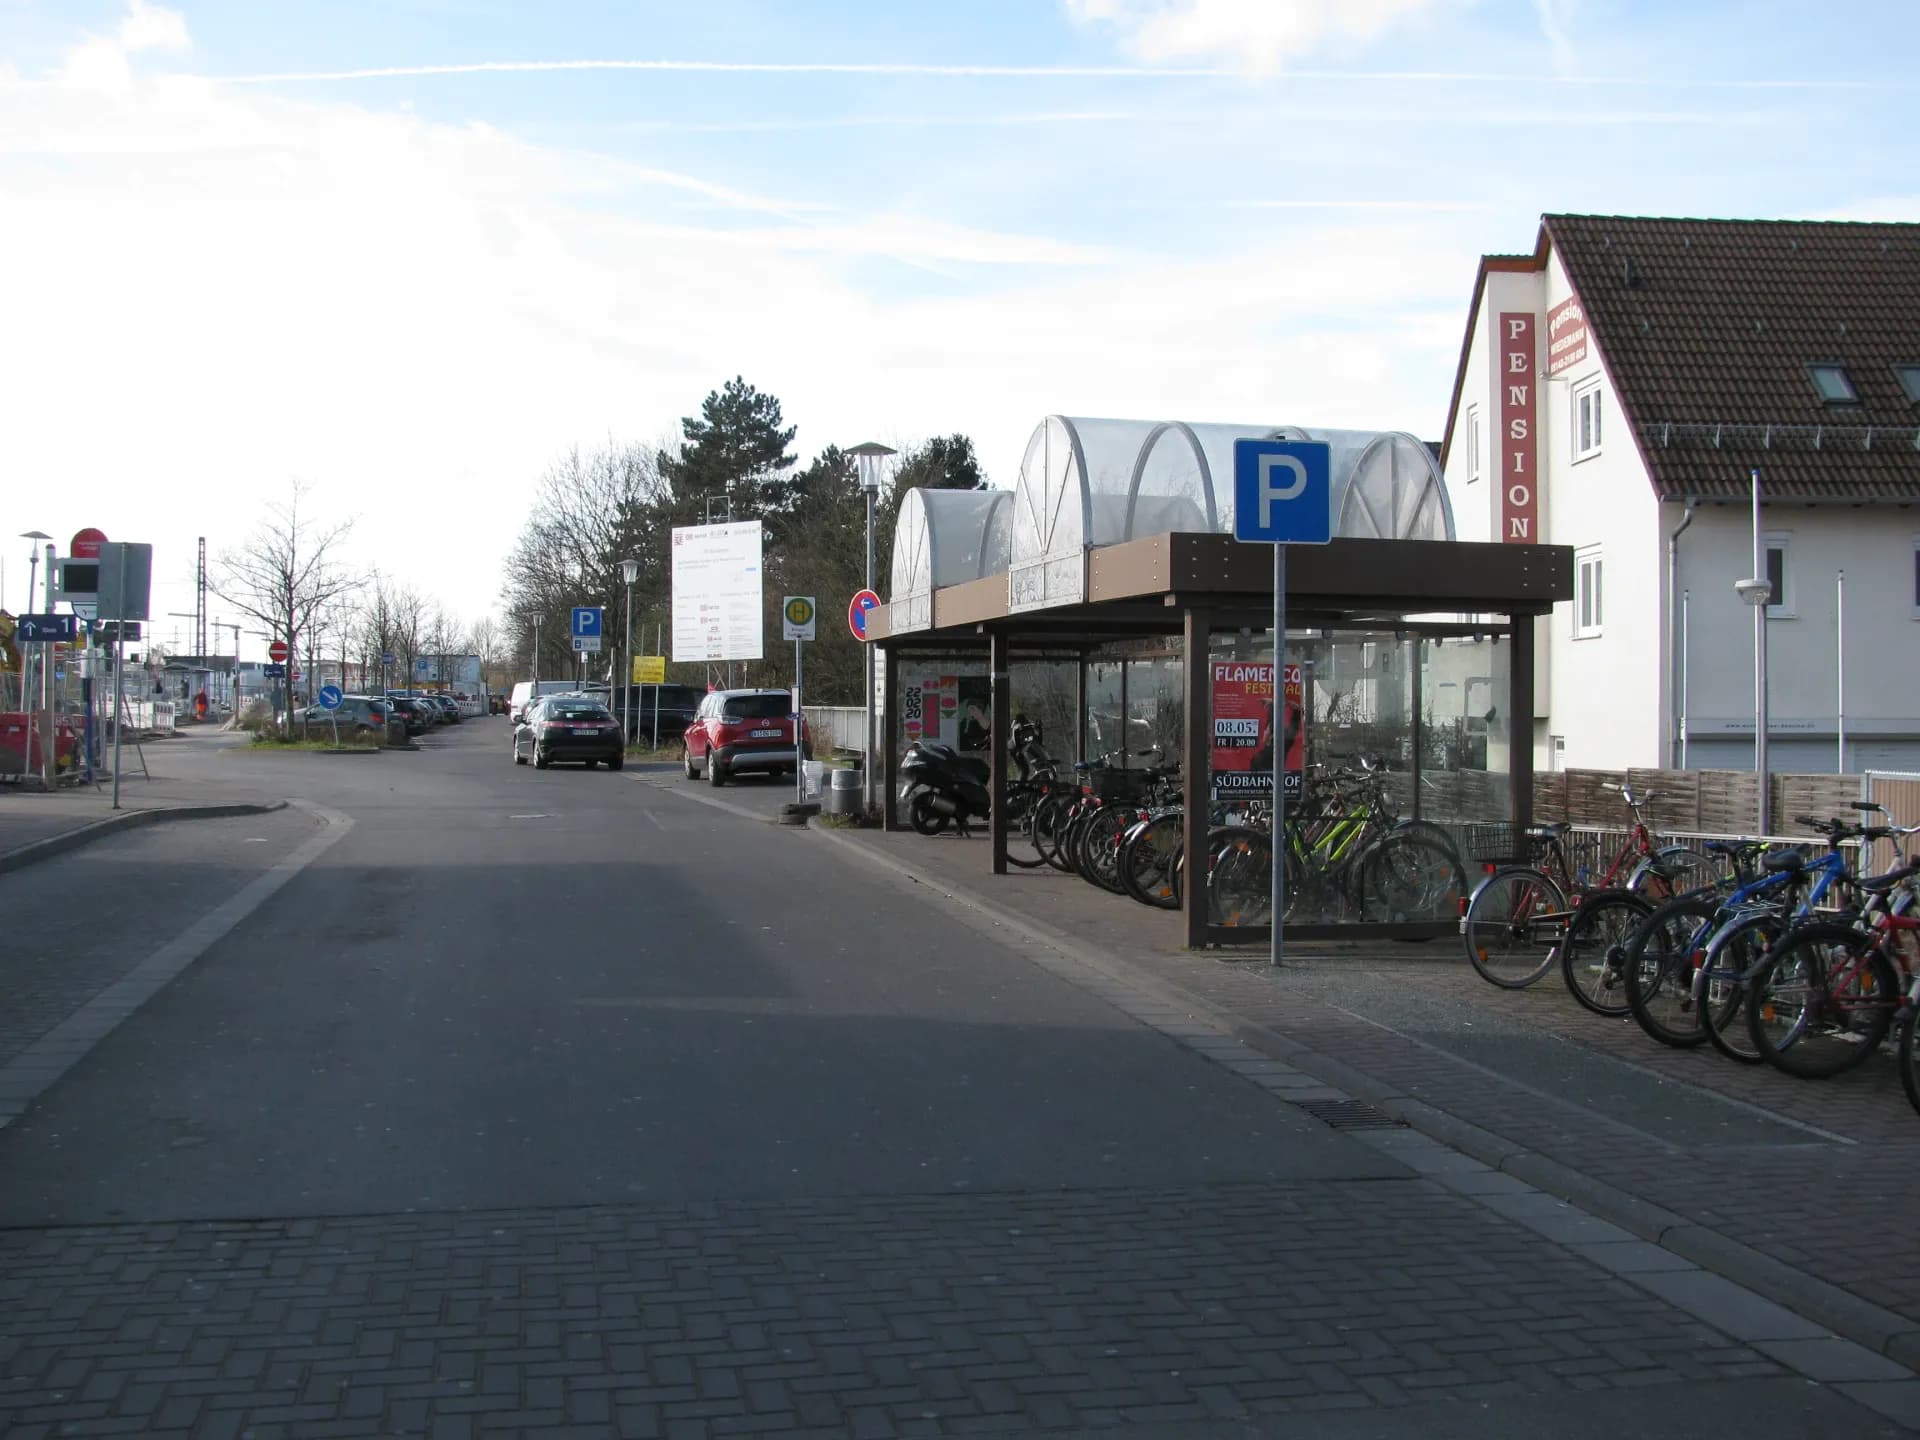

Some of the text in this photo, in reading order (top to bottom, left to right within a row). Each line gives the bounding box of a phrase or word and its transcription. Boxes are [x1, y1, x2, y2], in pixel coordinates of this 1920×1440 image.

[1509, 320, 1530, 538] PENSION
[1259, 454, 1307, 528] P
[793, 603, 805, 620] H
[61, 617, 69, 632] 1
[579, 611, 594, 632] P
[906, 687, 921, 697] 22
[1245, 682, 1301, 695] FESTAL
[906, 698, 921, 708] 02
[906, 708, 921, 719] 20
[1217, 721, 1256, 734] 08.05.
[1217, 738, 1227, 746] FR
[1236, 739, 1256, 747] 20.00
[1216, 774, 1301, 787] SÜDBAHNOF
